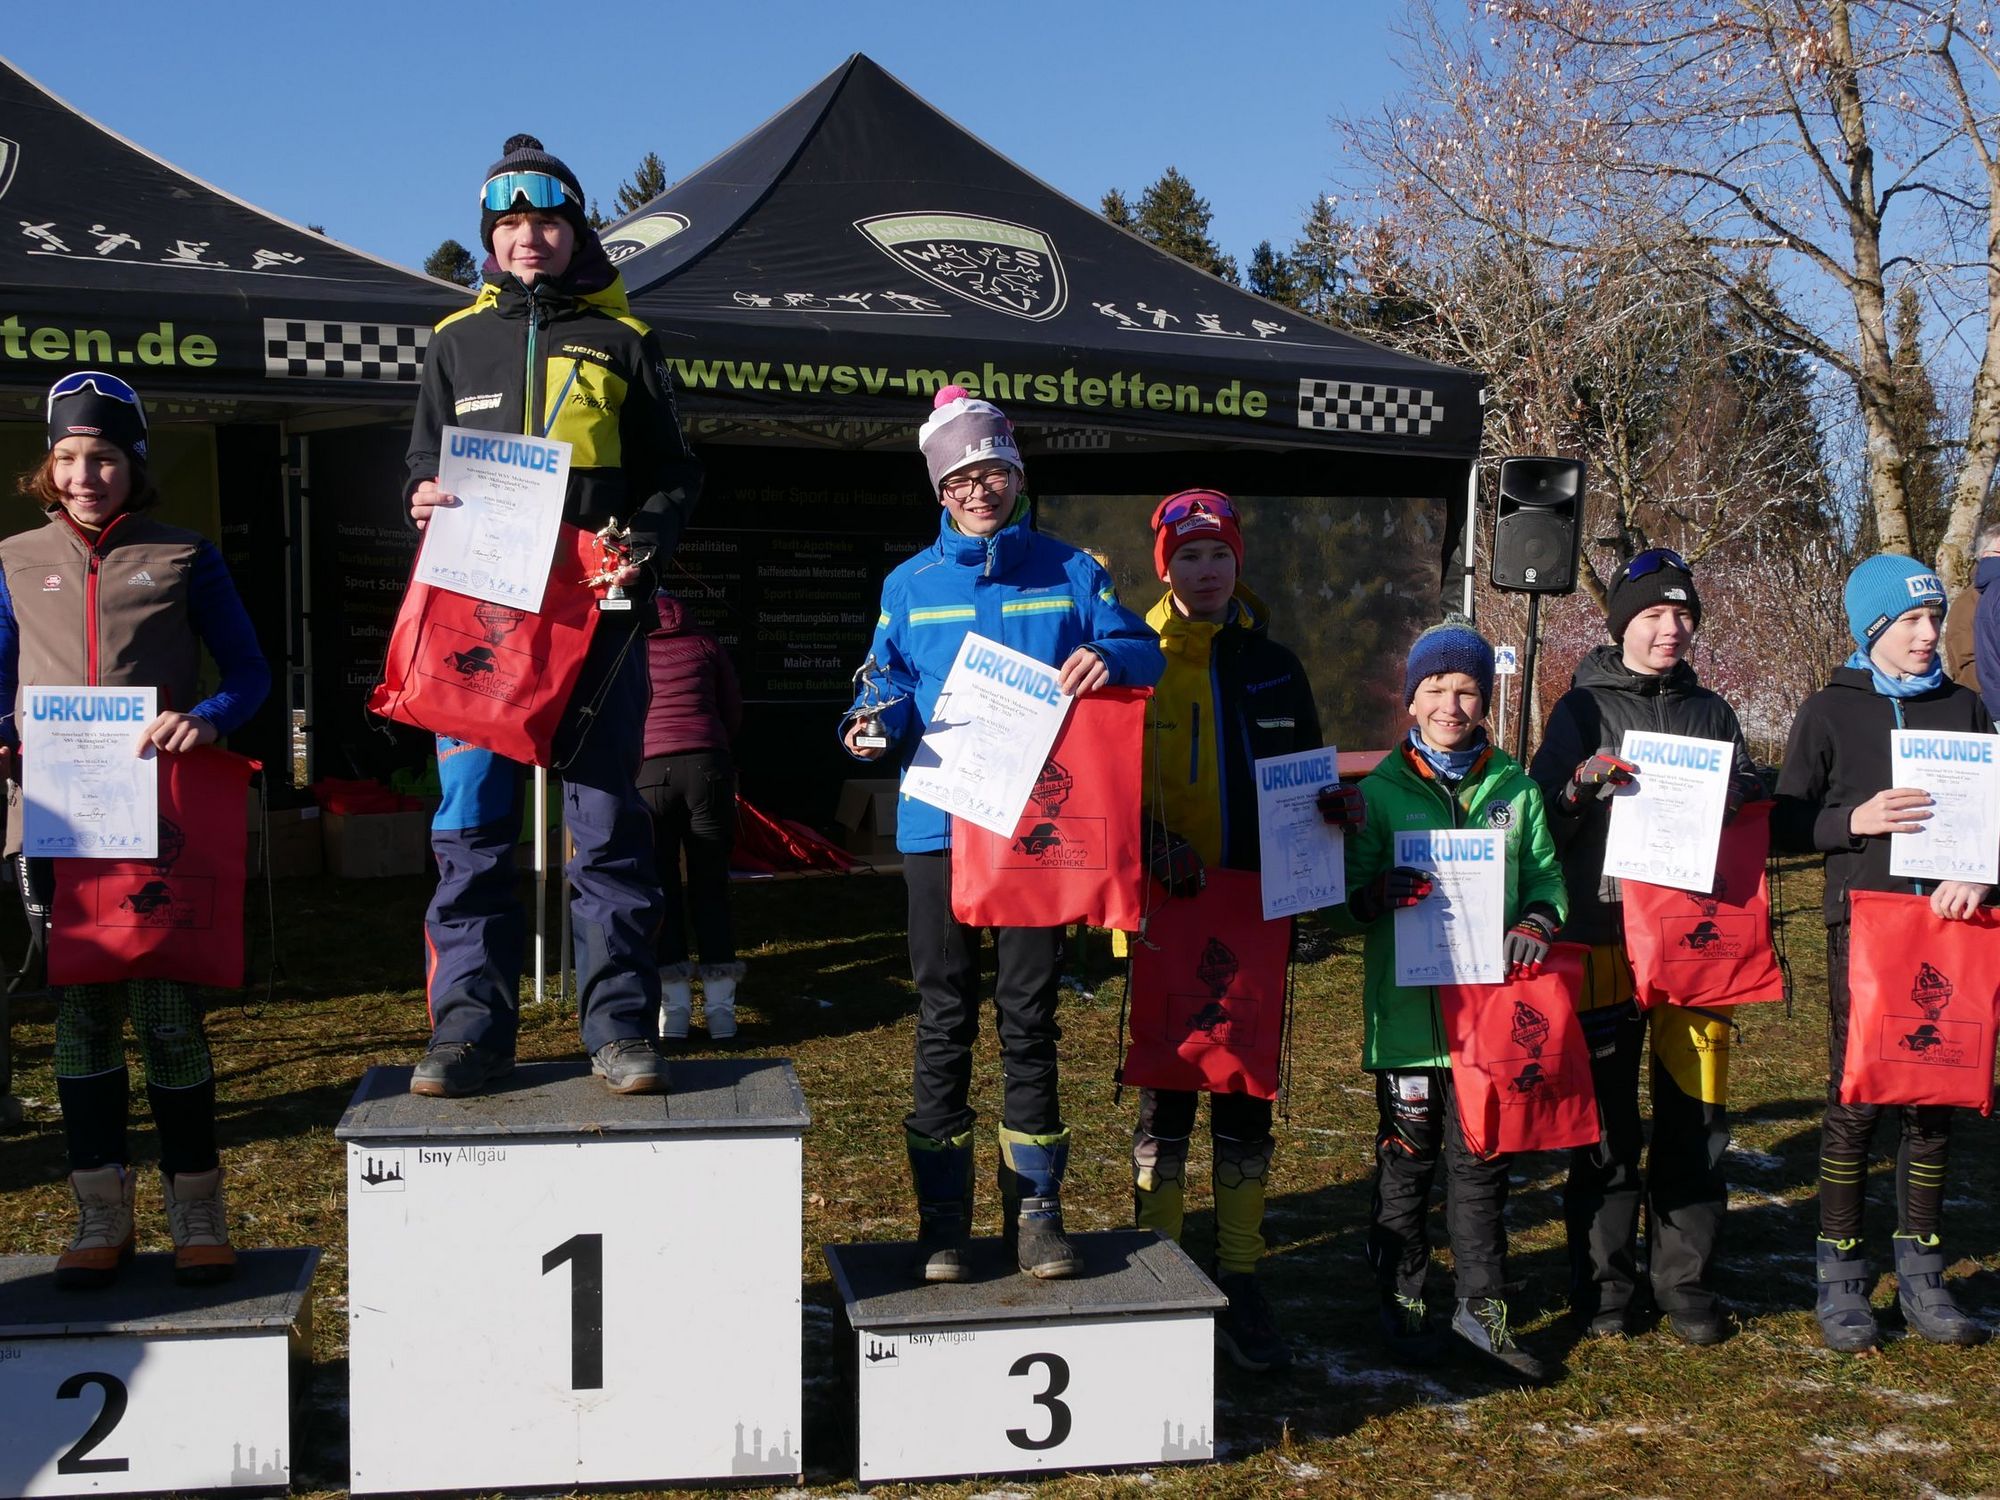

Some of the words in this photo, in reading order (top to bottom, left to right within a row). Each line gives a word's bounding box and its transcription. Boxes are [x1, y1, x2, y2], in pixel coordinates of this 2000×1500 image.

[878, 222, 1038, 247] MEHRSTETTEN
[1015, 251, 1040, 267] S
[562, 344, 613, 361] ziener
[471, 397, 502, 412] SBW
[450, 434, 560, 475] URKUNDE
[965, 435, 1010, 457] LEKI
[789, 488, 828, 507] Sport
[337, 525, 376, 537] Deutsche
[679, 541, 738, 553] pezialitäten
[757, 566, 811, 579] Raiffeisenbank
[812, 567, 853, 579] Mehrstetten
[854, 568, 867, 579] eG
[128, 579, 156, 587] adidas
[344, 575, 376, 590] Sport
[668, 586, 704, 599] auders
[706, 586, 728, 599] Hof
[763, 590, 795, 602] Sport
[797, 590, 862, 602] Wiedenmann
[758, 611, 839, 624] Steuerberatungsbüro
[841, 611, 866, 624] Wetzel
[784, 656, 810, 669] Maler
[813, 656, 842, 669] Kraft
[462, 661, 518, 693] Schloss
[964, 643, 1063, 707] URKUNDE
[467, 680, 513, 700] APOTHEKE
[768, 679, 803, 691] Elektro
[32, 695, 145, 722] URKUNDE
[1628, 739, 1722, 773] URKUNDE
[1900, 738, 1993, 764] URKUNDE
[1262, 755, 1333, 791] URKUNDE
[1031, 840, 1088, 862] Schloss
[1402, 838, 1495, 862] URKUNDE
[1041, 859, 1085, 867] APOTHEKE
[1694, 936, 1741, 954] Schloss
[1914, 1039, 1964, 1056] Schloss
[1923, 1055, 1961, 1064] APOTHEKE
[418, 1148, 452, 1167] Isny
[456, 1147, 506, 1167] Allgäu
[541, 1232, 603, 1391] 1
[908, 1332, 934, 1347] Isny
[1005, 1352, 1073, 1450] 3
[56, 1371, 130, 1475] 2
